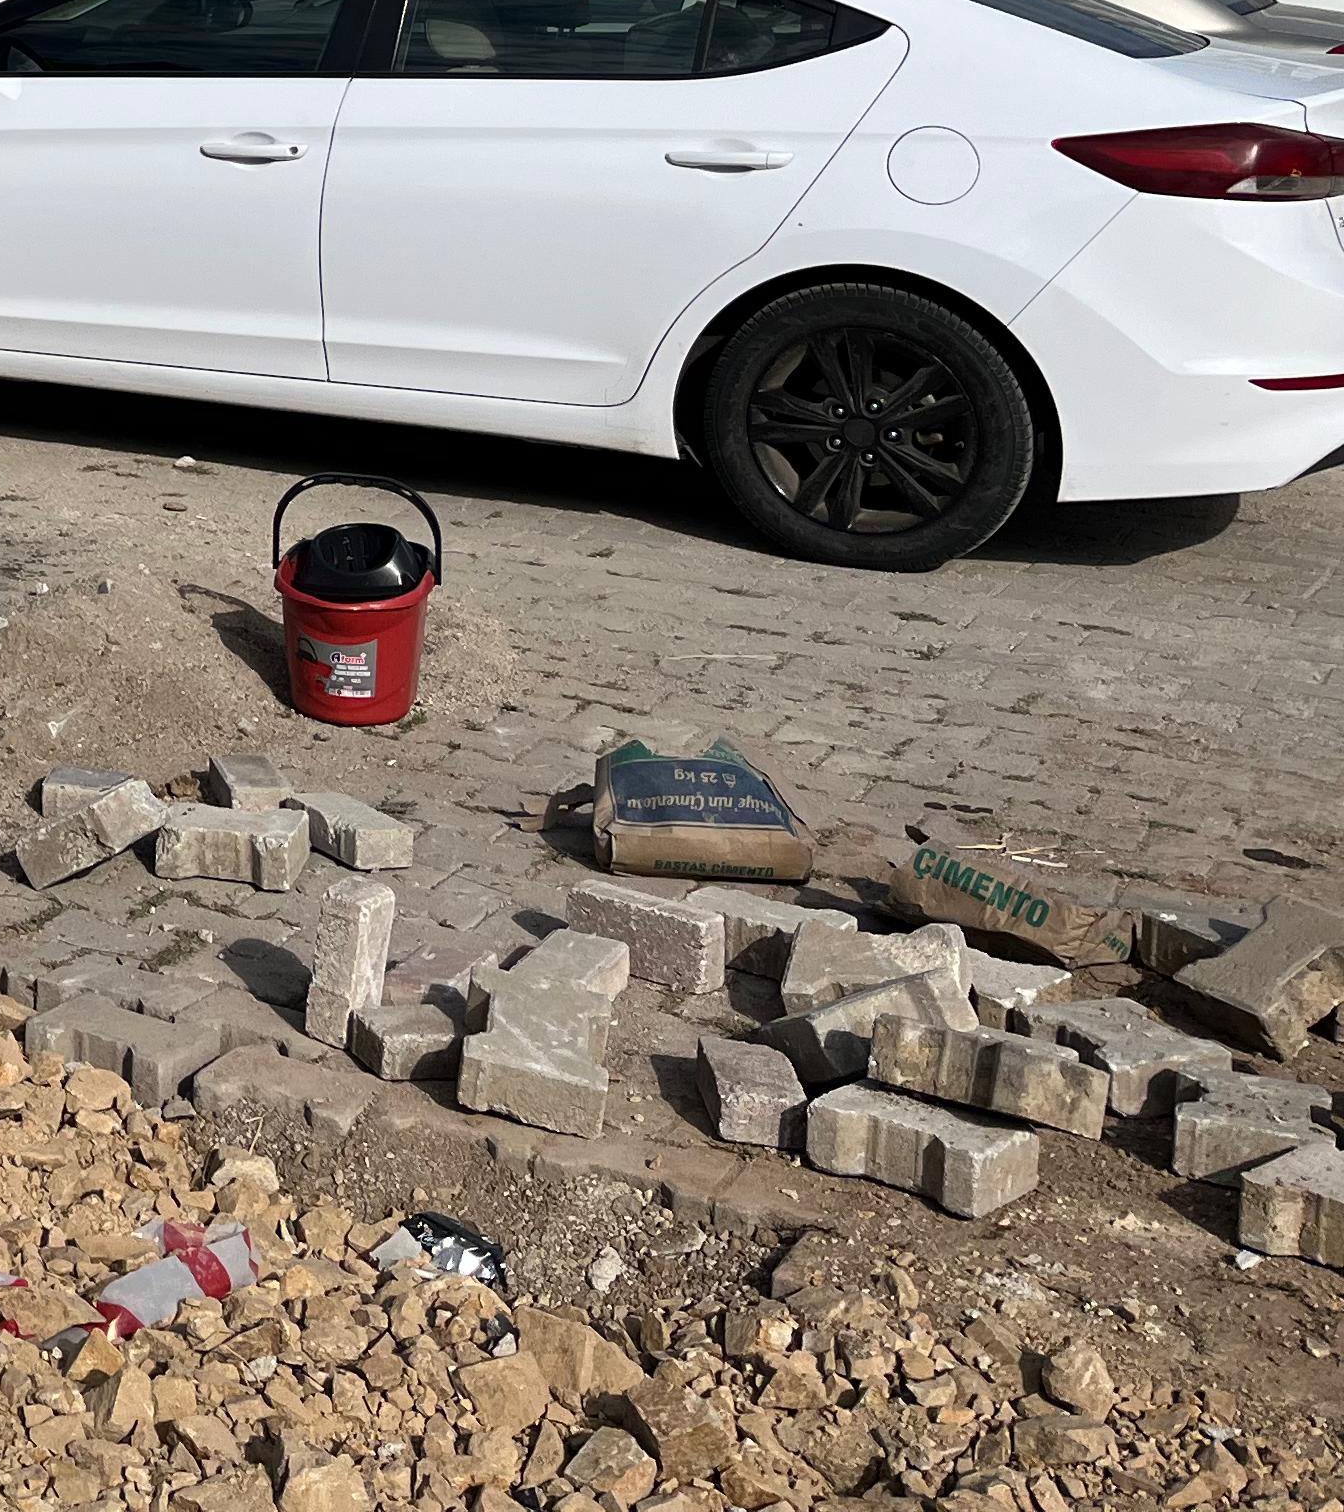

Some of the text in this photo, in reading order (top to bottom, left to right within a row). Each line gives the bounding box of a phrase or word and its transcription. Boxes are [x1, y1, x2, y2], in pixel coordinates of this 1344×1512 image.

[673, 768, 719, 784] 25 kg
[912, 848, 1050, 929] ÇİMENTO
